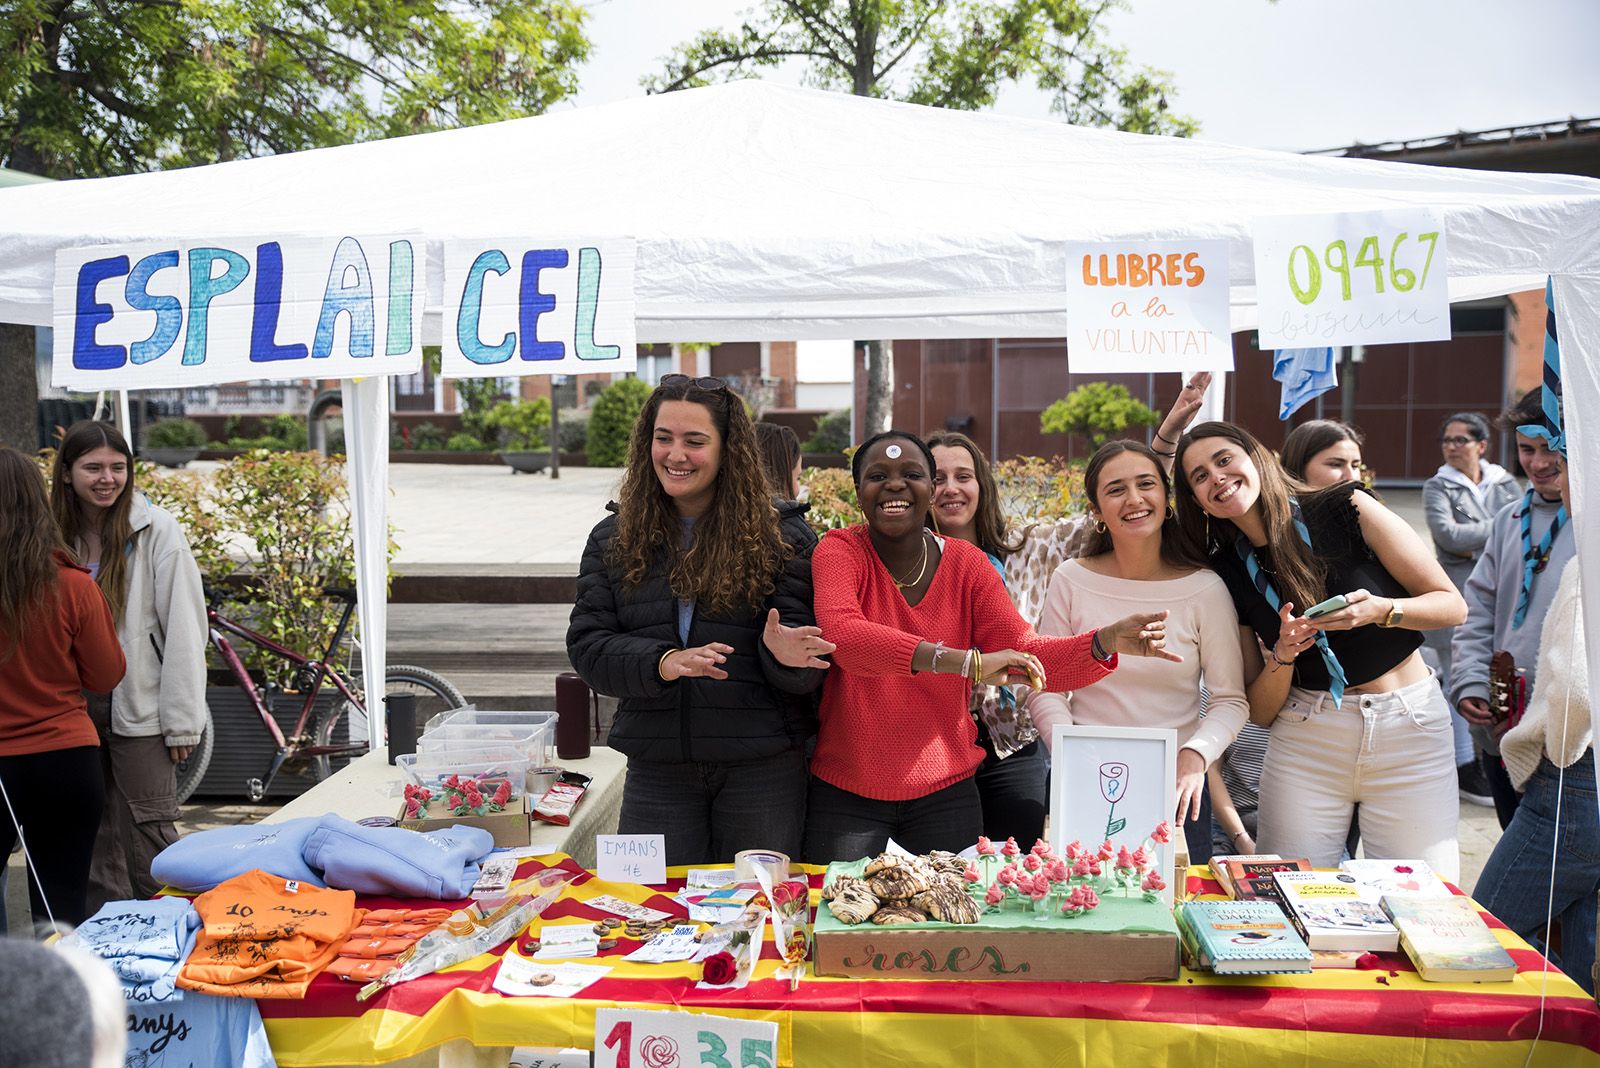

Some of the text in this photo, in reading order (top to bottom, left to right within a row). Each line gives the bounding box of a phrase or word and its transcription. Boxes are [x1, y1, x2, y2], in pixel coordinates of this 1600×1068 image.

[1082, 252, 1205, 287] LLIBRES
[1288, 232, 1439, 305] 09467
[73, 236, 621, 370] ESPLAI CEL
[1111, 297, 1175, 318] a la
[1085, 328, 1213, 354] VOLUNTAT
[604, 840, 658, 857] IMANS
[623, 864, 642, 878] 4€
[226, 903, 329, 919] 10 anys
[1207, 908, 1274, 916] SEBASTIAN
[1433, 927, 1466, 937] Girl
[842, 944, 1031, 975] roses
[125, 1012, 192, 1054] anys
